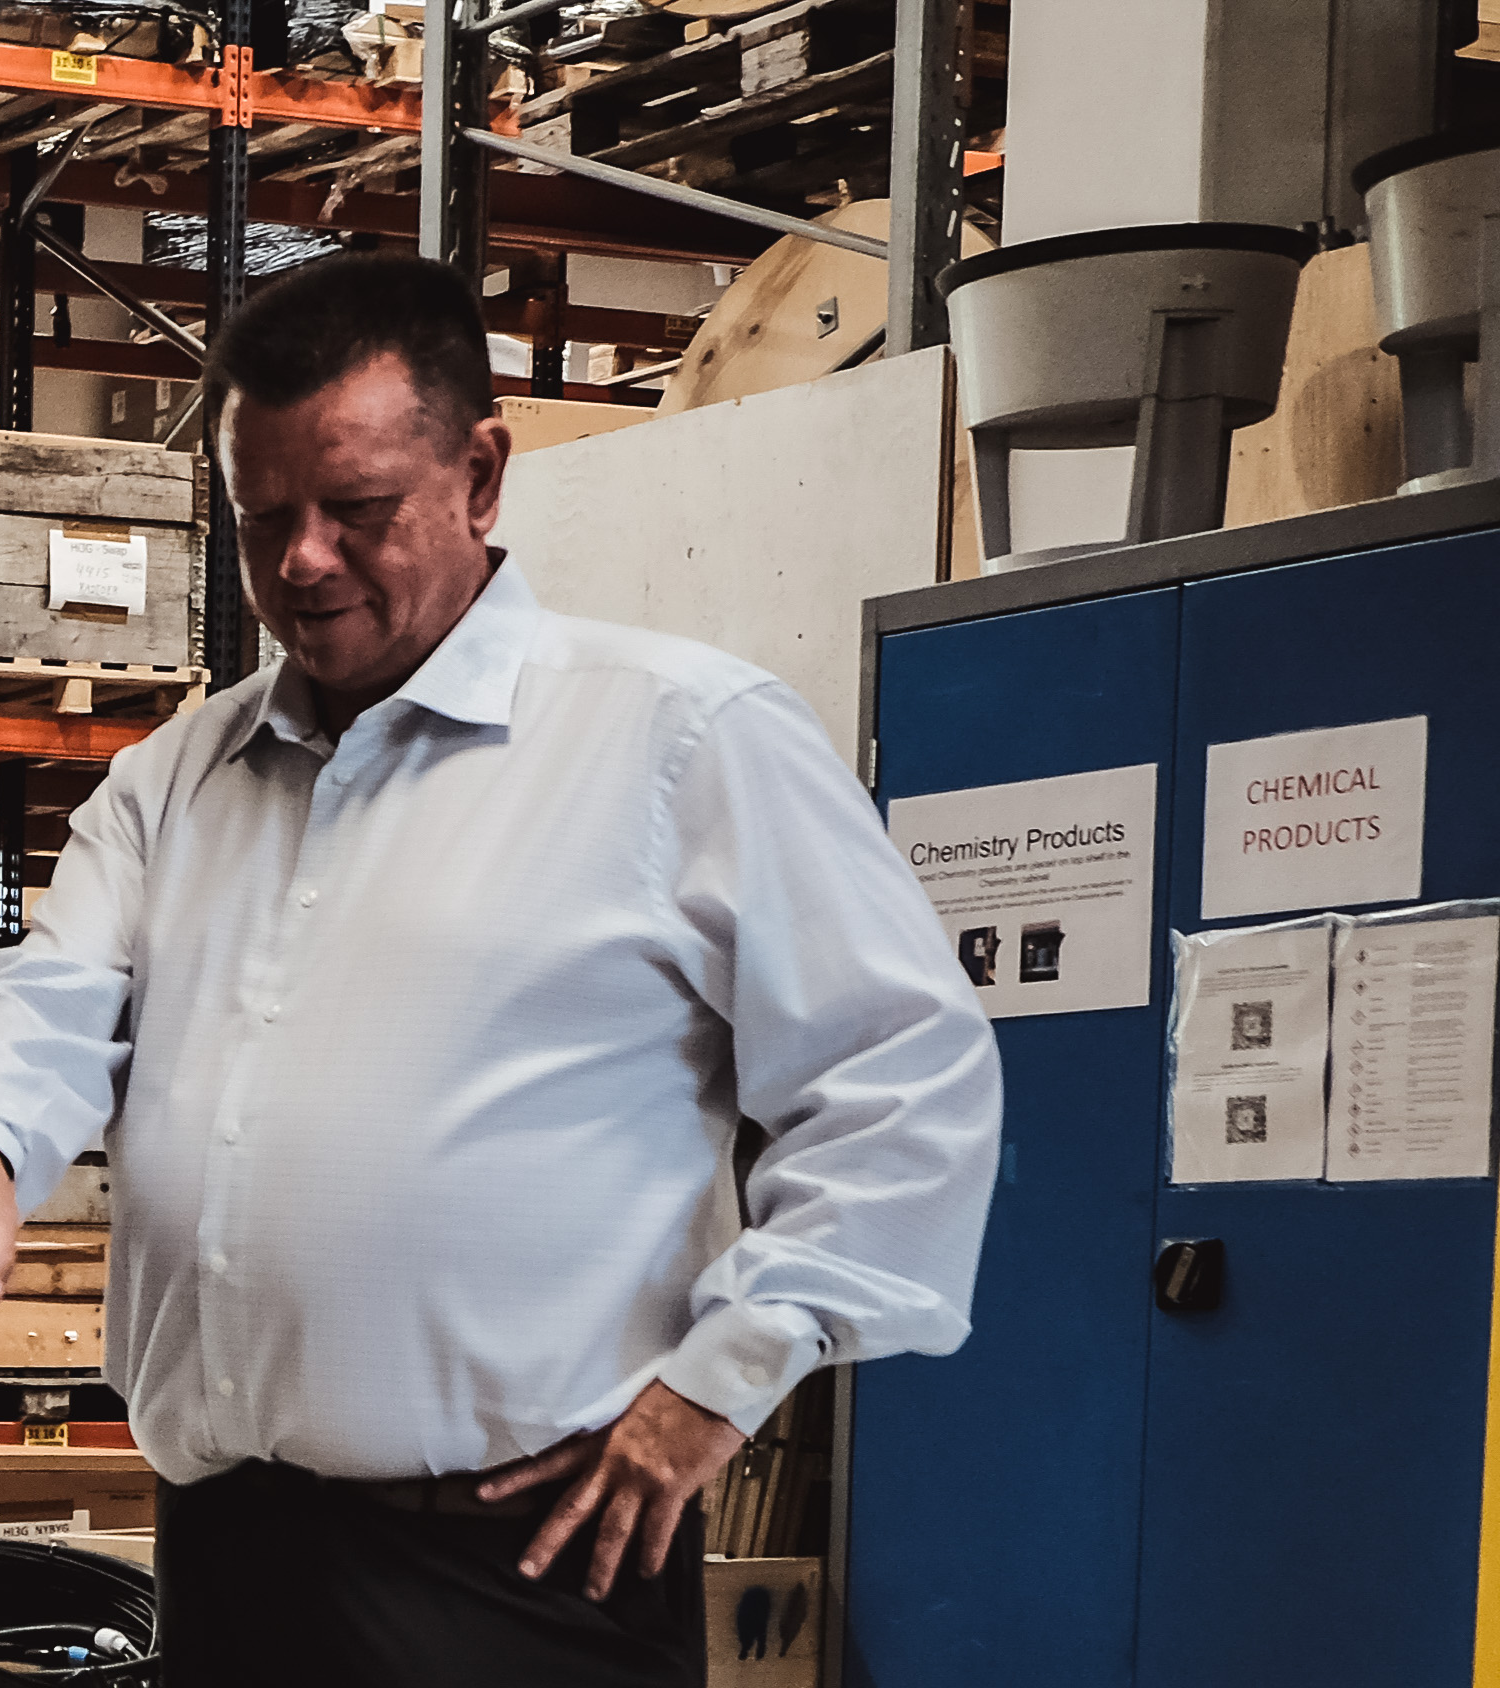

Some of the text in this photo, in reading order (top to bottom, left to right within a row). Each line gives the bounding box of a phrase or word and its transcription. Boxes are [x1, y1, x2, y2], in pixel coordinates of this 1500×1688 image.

[1247, 765, 1381, 805] CHEMICAL
[910, 821, 1125, 866] Chemistry Products
[1242, 815, 1382, 854] PRODUCTS
[3, 1523, 69, 1536] HI3G NYBYG
